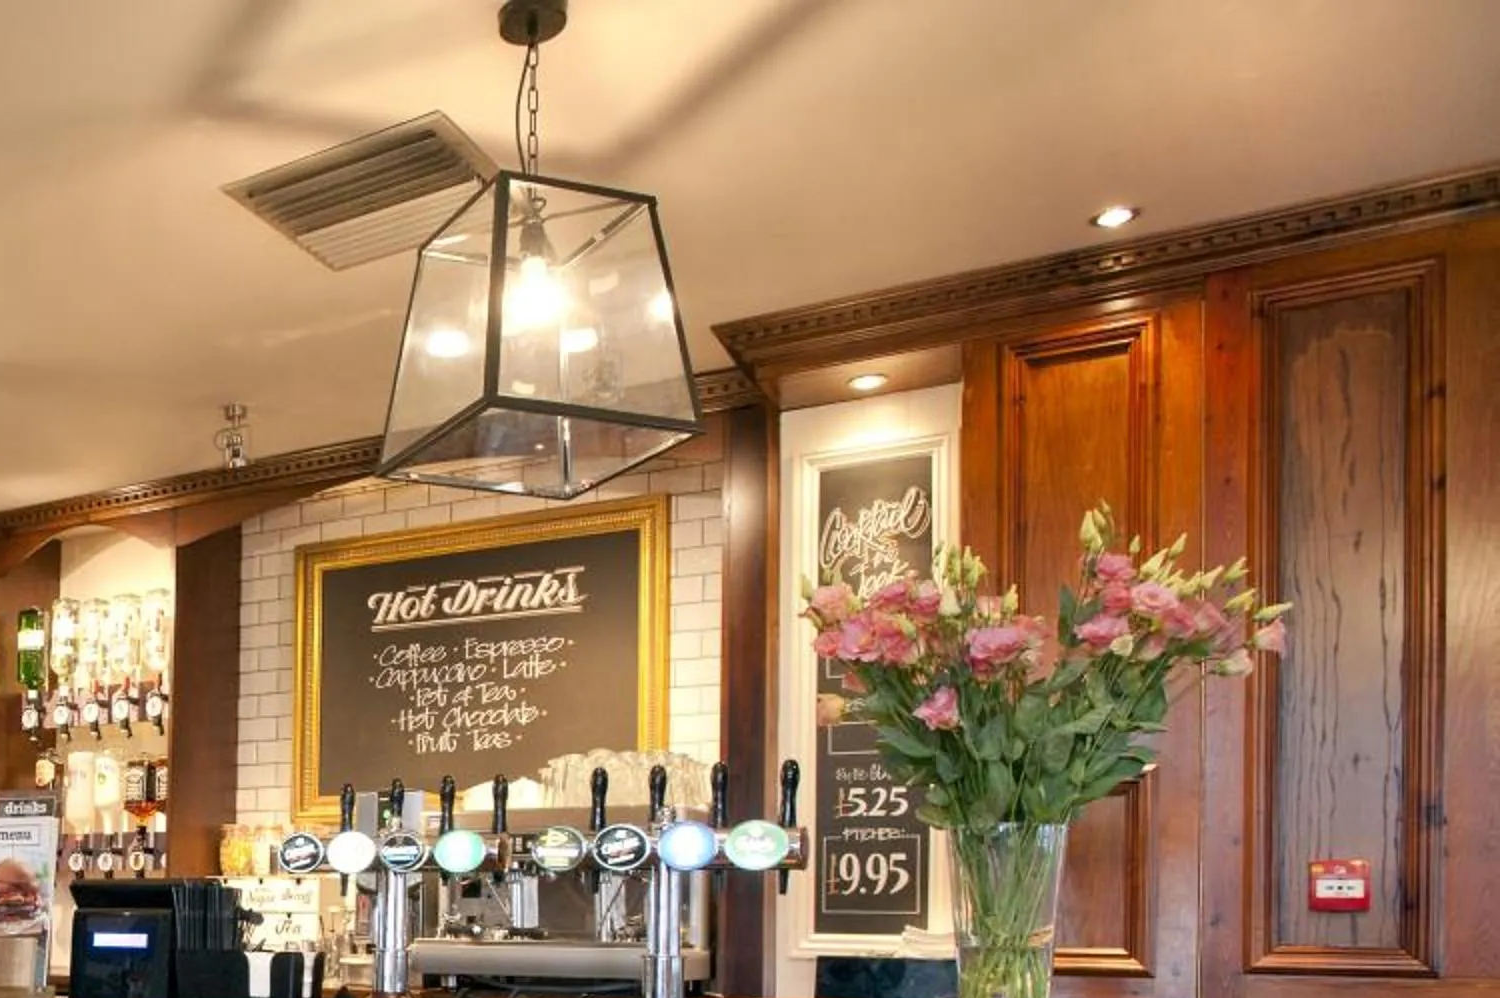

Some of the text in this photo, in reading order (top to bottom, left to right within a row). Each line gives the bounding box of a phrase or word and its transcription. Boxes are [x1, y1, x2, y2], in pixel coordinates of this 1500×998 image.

[368, 572, 588, 624] Hot Drinks
[379, 637, 565, 667] Coffee Espresso
[503, 652, 556, 679] Latte
[475, 682, 516, 704] Tea
[400, 701, 540, 732] Hot Chocolate
[466, 729, 512, 751] Teas
[4, 801, 47, 815] drinks
